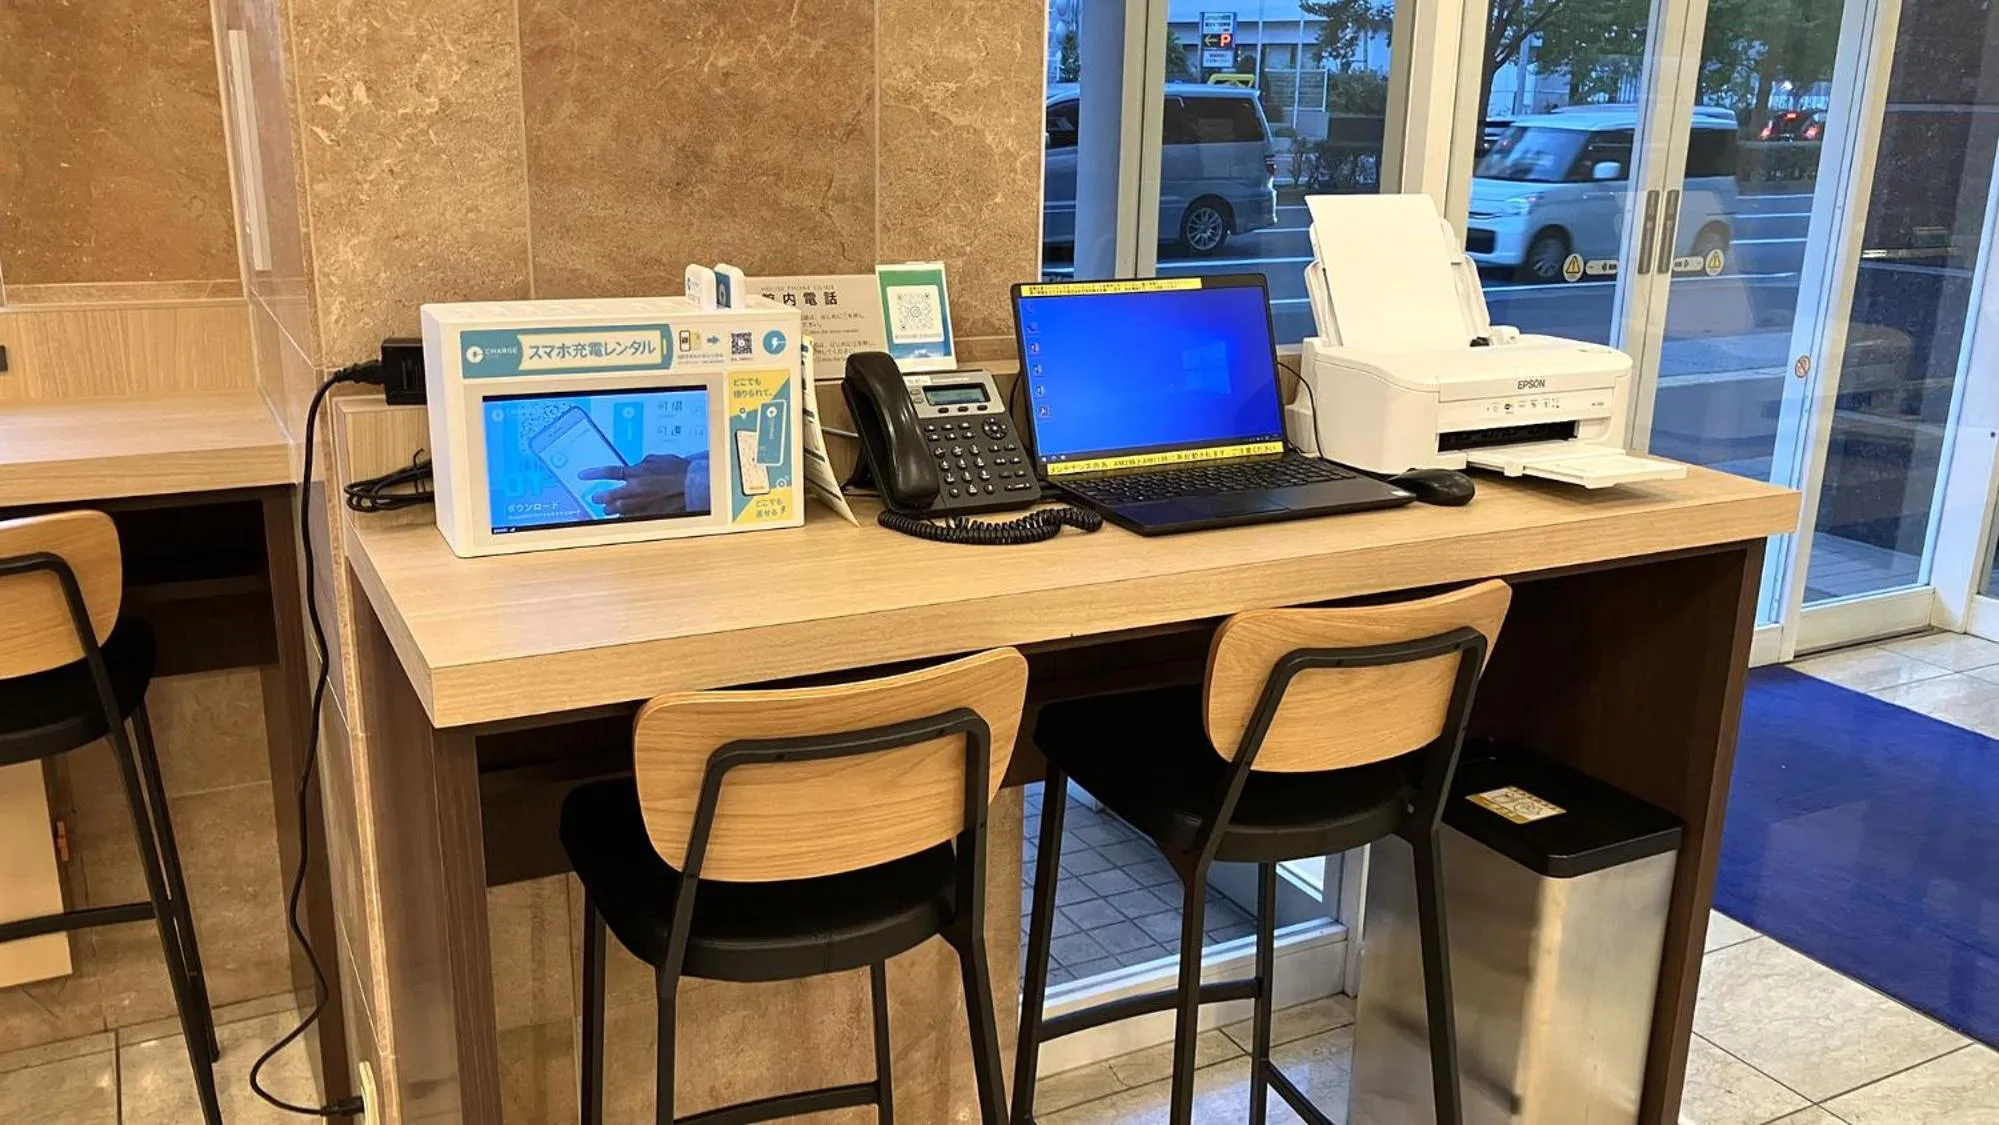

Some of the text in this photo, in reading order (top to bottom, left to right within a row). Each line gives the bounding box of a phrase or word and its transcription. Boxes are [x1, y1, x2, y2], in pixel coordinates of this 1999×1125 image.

[1221, 34, 1231, 47] P
[528, 339, 656, 361] スマホ充電レンタル
[1517, 379, 1546, 390] EPSON
